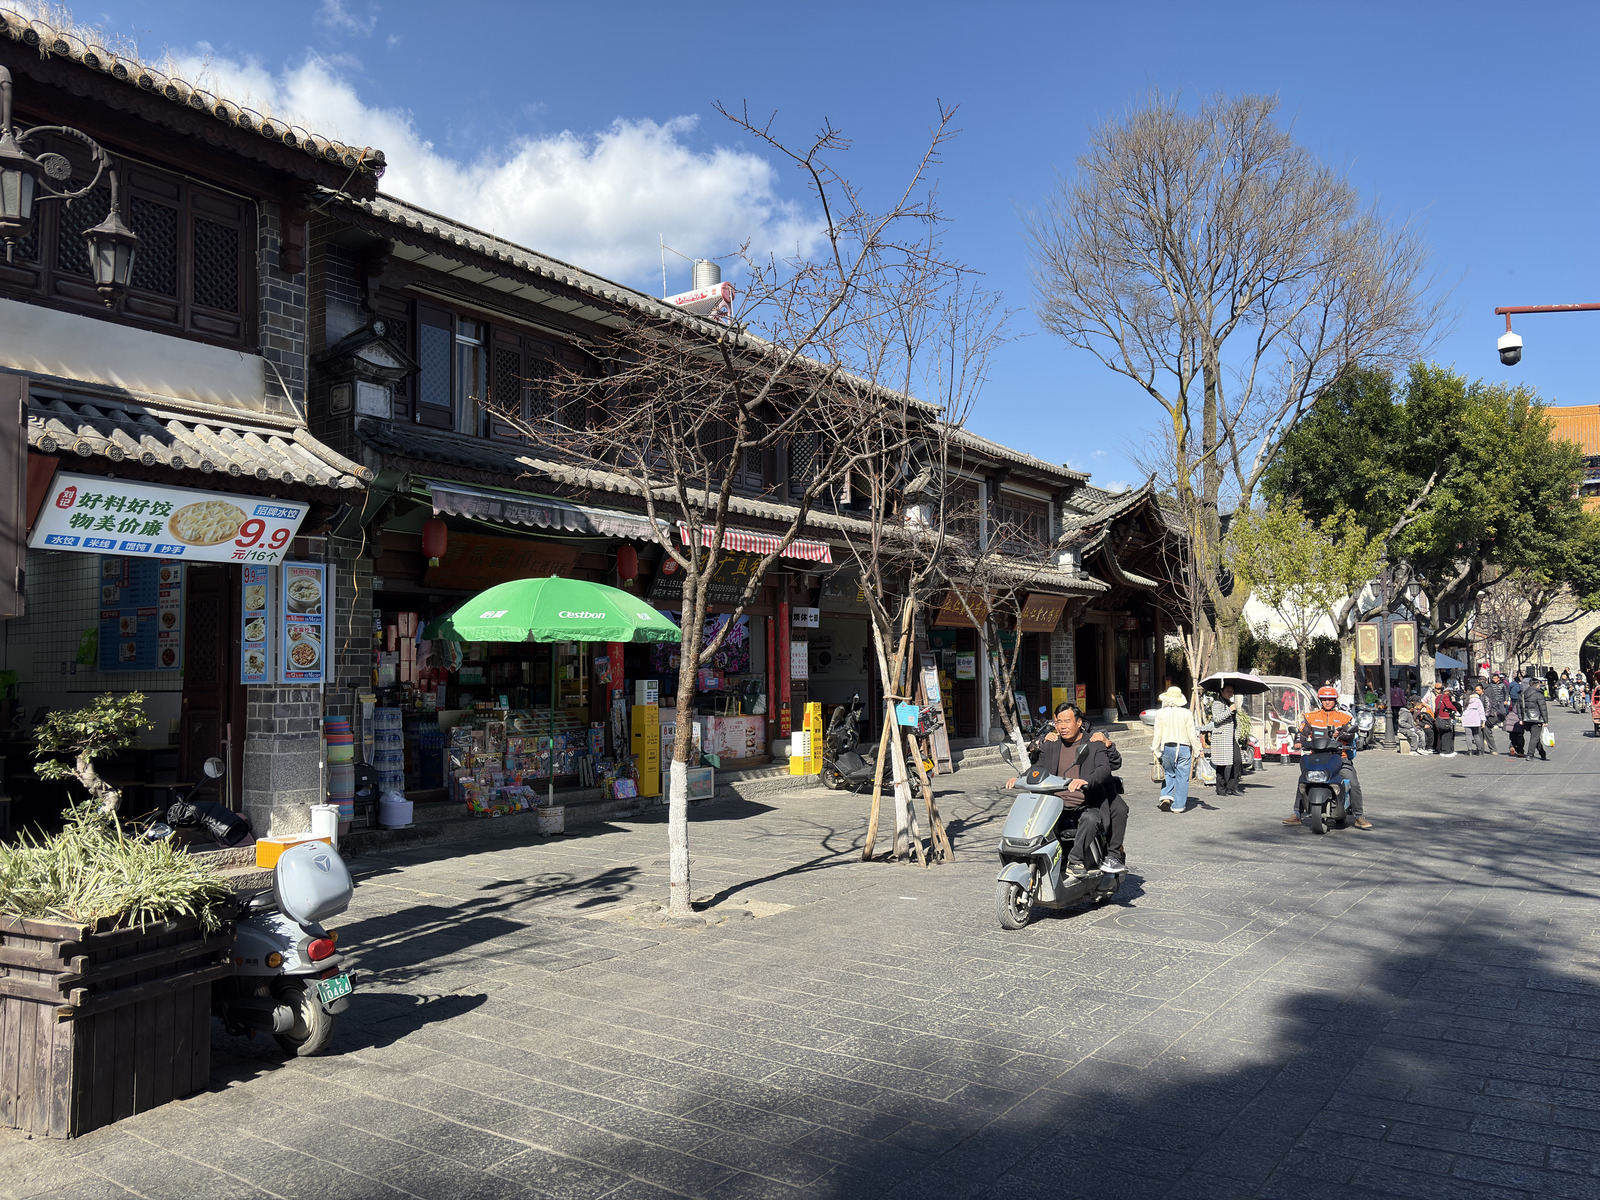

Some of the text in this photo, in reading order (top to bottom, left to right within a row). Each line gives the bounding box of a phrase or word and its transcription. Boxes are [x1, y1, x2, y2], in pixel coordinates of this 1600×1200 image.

[60, 490, 75, 507] 刘记
[76, 492, 174, 517] 好料好饺
[256, 506, 299, 519] 招牌水饺
[69, 512, 164, 537] 物美价廉
[234, 518, 291, 550] 9.9
[51, 535, 182, 554] 水饺 米线 馄饨 抄手
[231, 549, 279, 563] 元/16个
[323, 982, 350, 1001] 10464
